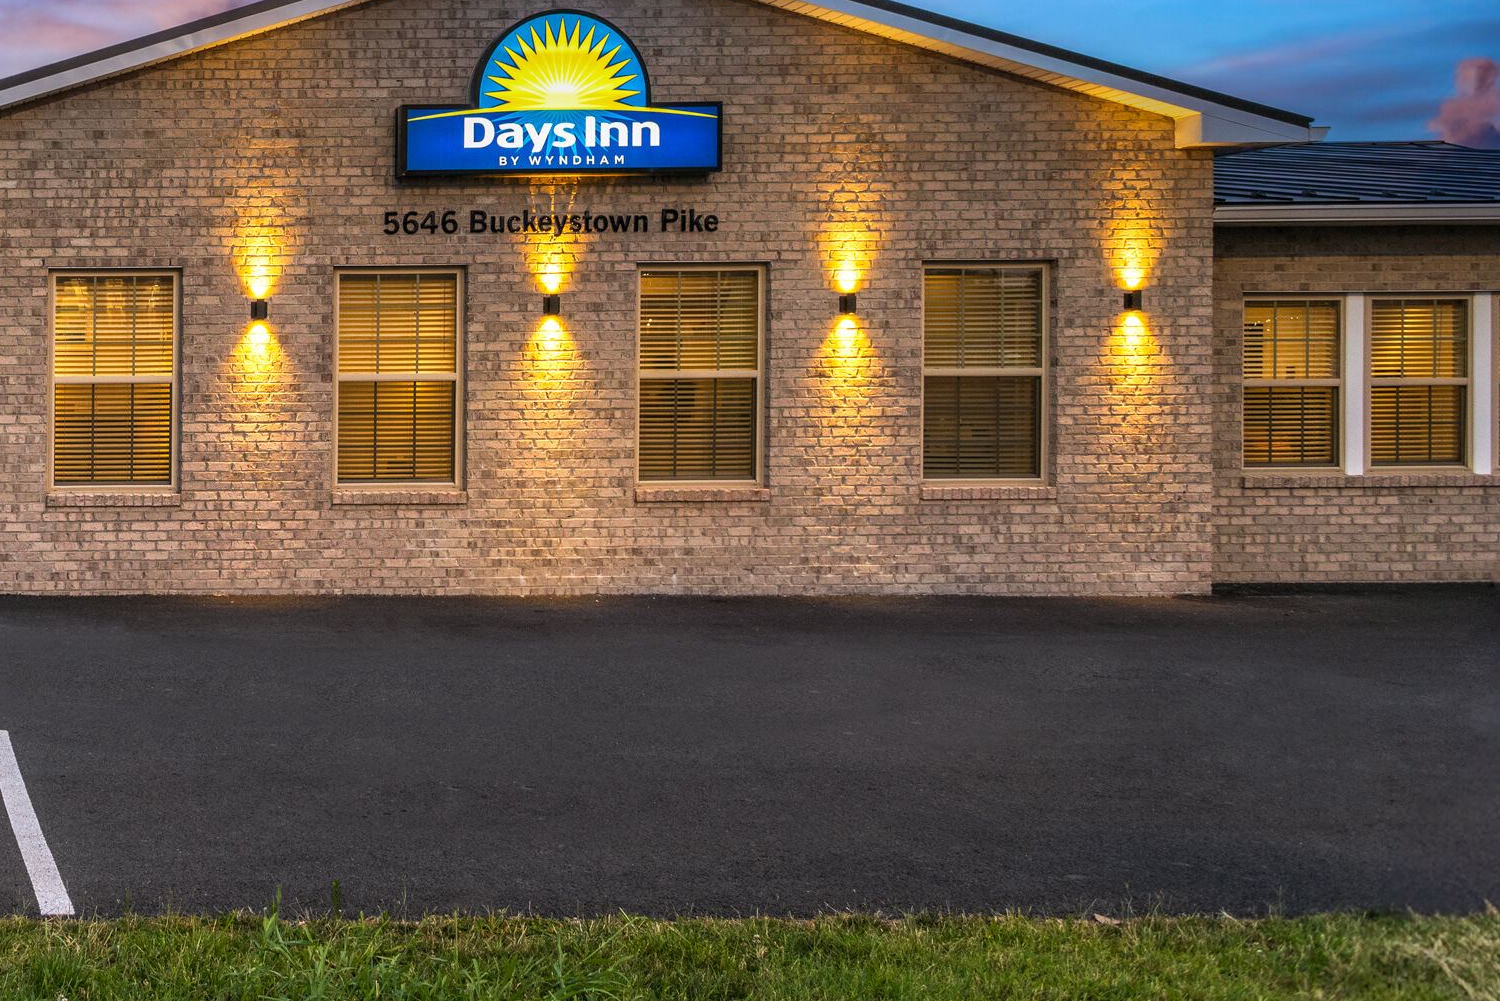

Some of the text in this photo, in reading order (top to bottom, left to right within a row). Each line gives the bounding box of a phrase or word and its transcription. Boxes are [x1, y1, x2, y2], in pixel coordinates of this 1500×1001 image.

[463, 115, 661, 153] Days Inn
[499, 154, 626, 166] BY WYNDHAM
[383, 208, 720, 237] 5646 Buckeystown Pike
